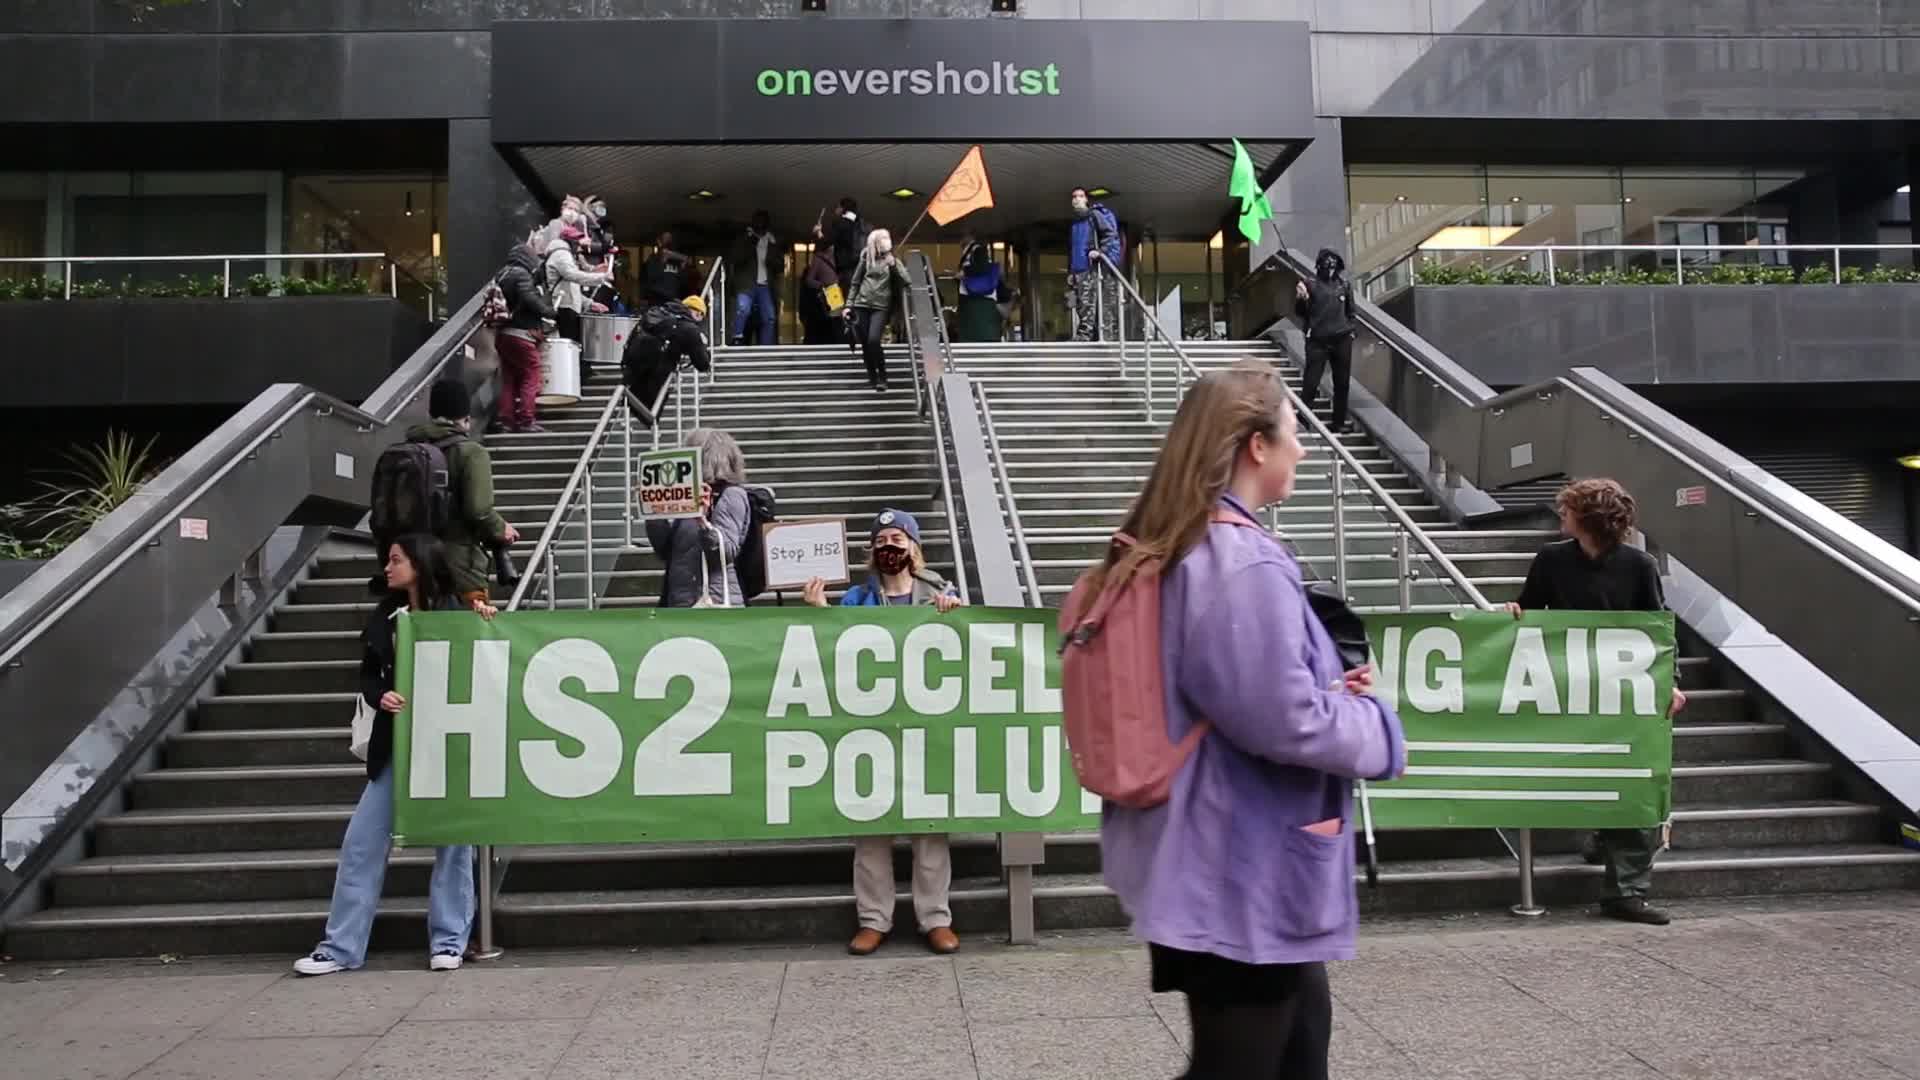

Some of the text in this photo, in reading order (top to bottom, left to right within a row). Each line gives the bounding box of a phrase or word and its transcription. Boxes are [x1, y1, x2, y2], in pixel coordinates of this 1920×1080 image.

[756, 61, 1060, 95] oneversholtst
[642, 461, 691, 486] STOP
[641, 487, 693, 502] ECOCIDE
[770, 542, 840, 562] Stop HS2
[1498, 627, 1657, 715] AIR
[409, 637, 732, 798] HS2
